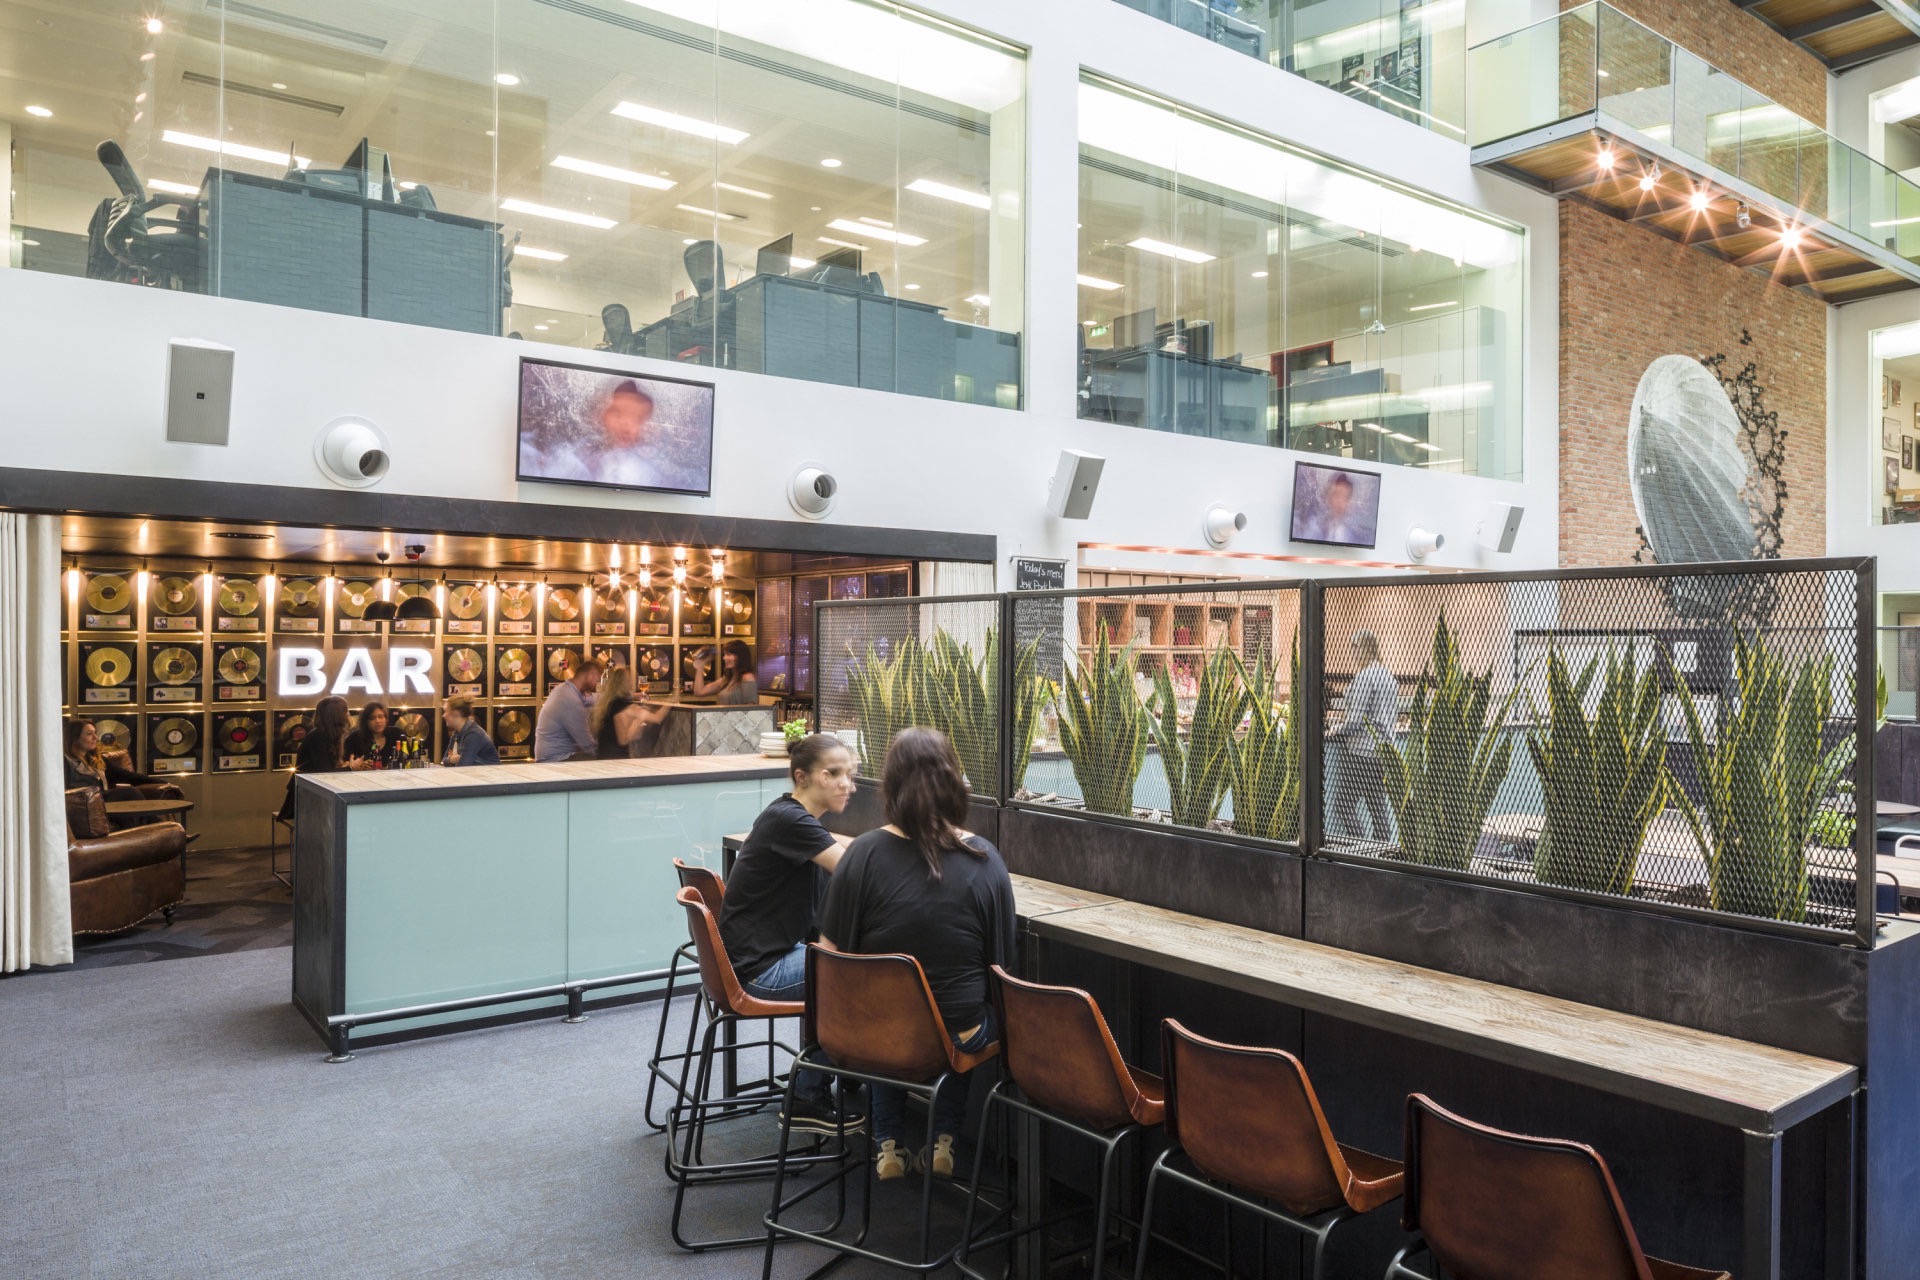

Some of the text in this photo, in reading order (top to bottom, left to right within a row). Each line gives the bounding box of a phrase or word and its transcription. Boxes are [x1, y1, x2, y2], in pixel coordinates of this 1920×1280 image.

[1023, 561, 1063, 580] Today's menu
[278, 647, 436, 696] BAR
